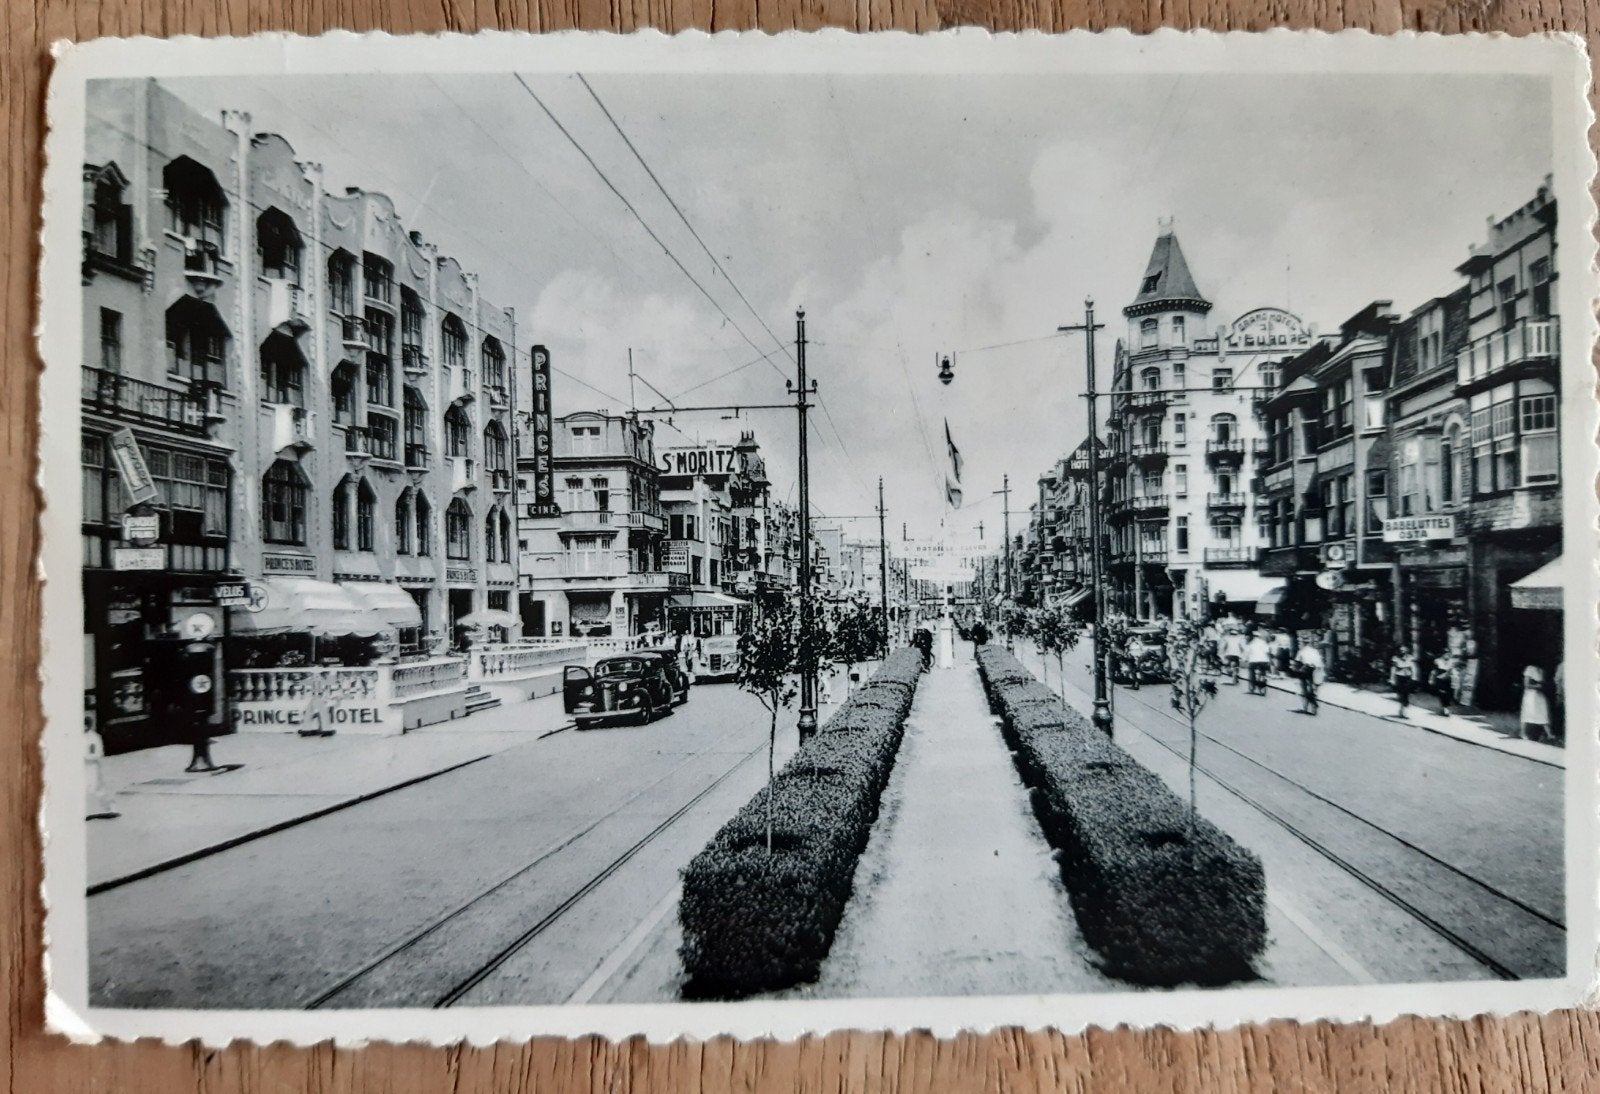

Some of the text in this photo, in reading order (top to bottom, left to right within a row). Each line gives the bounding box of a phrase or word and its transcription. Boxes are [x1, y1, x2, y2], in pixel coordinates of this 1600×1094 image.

[534, 351, 550, 498] PRINCE'S
[677, 450, 736, 475] MORITZ
[1385, 518, 1450, 531] BABELUTTES
